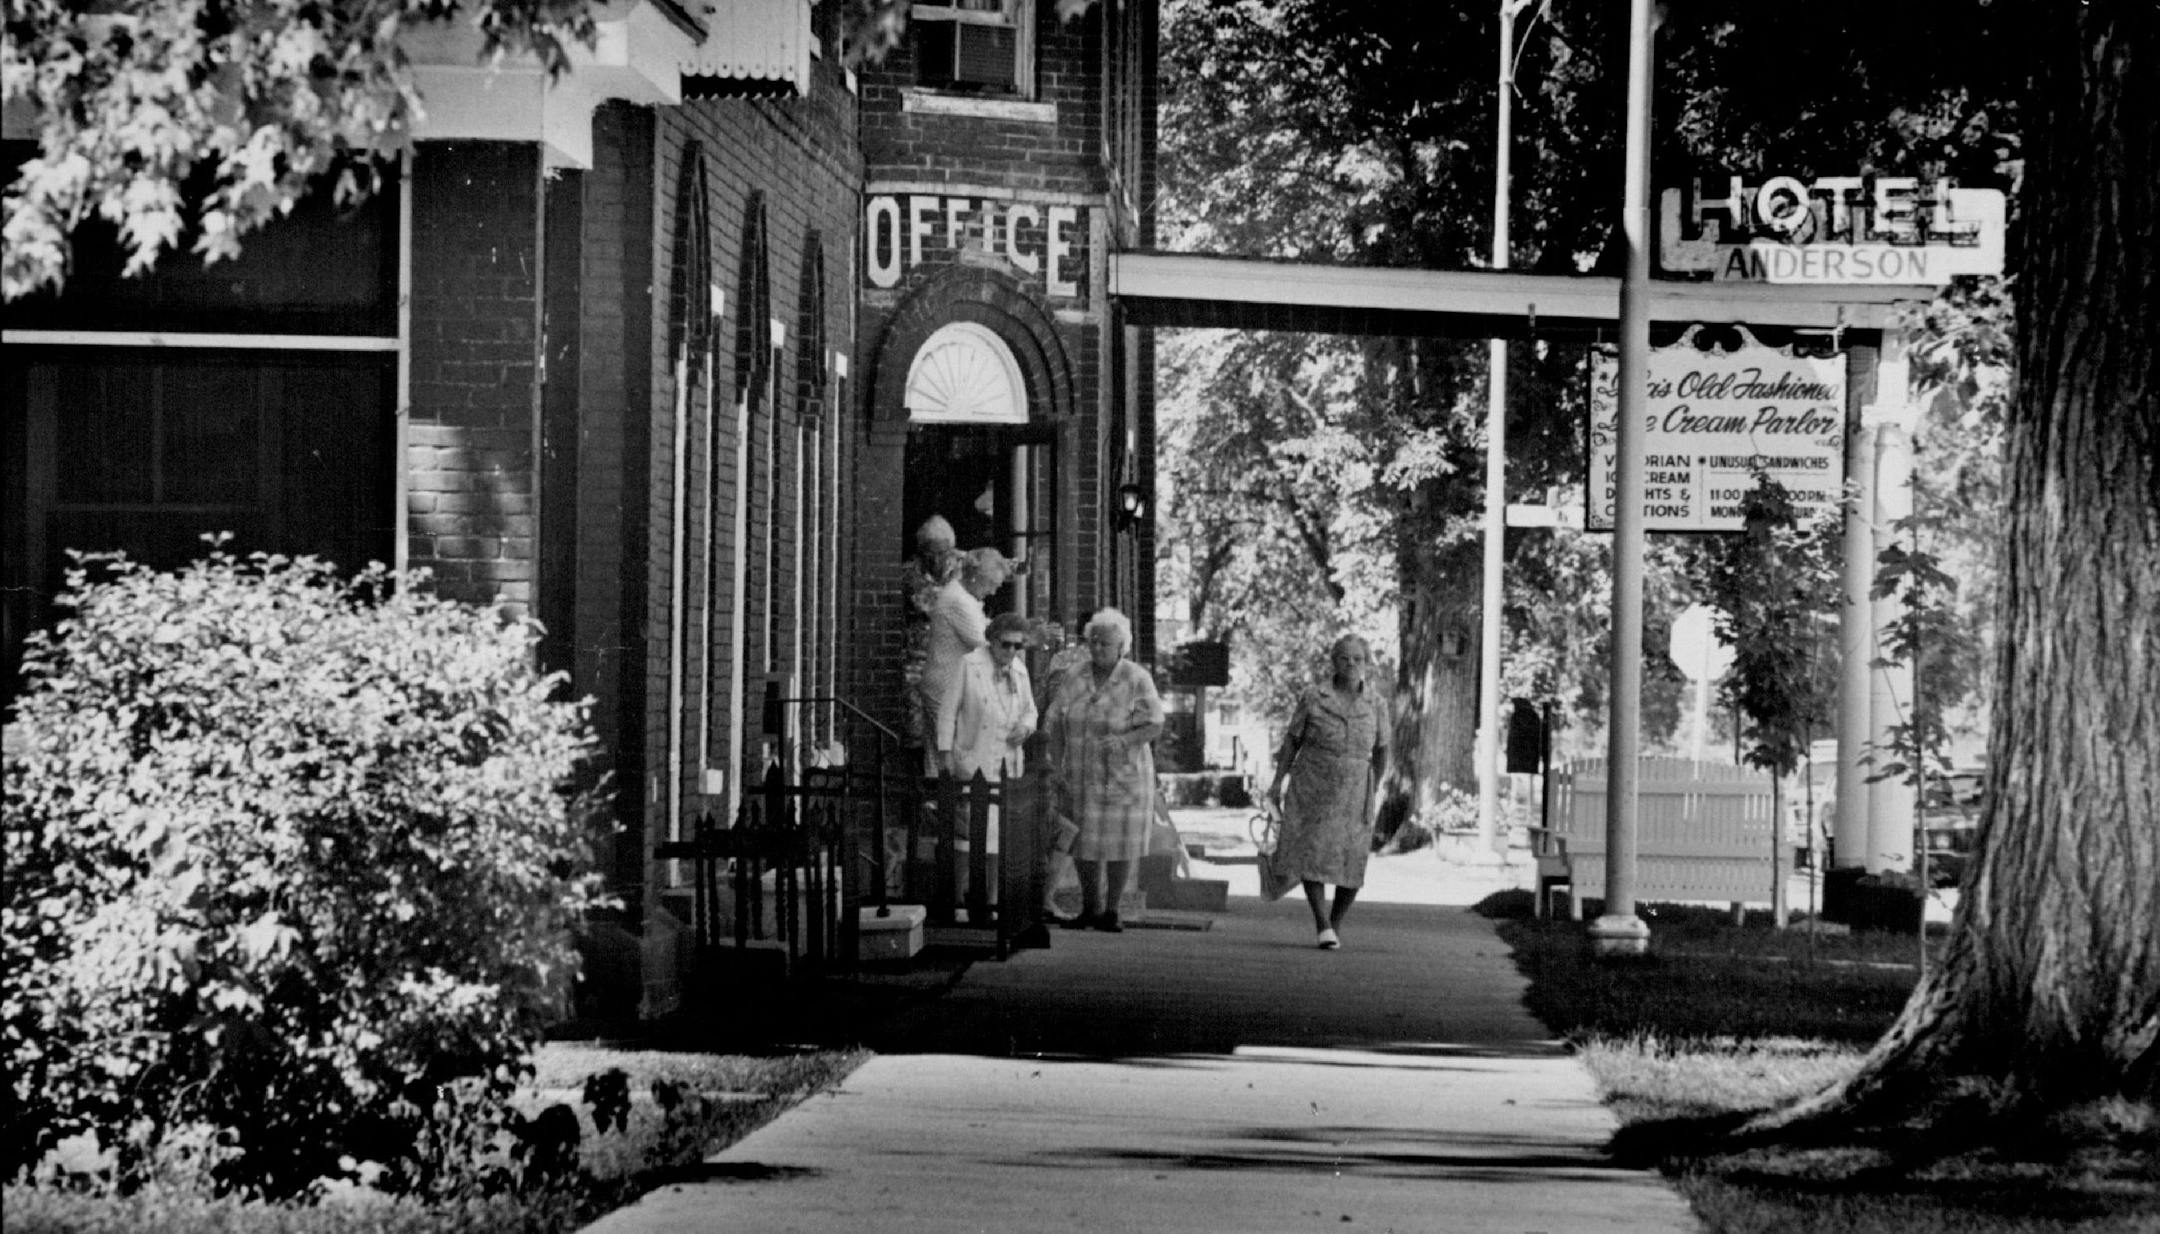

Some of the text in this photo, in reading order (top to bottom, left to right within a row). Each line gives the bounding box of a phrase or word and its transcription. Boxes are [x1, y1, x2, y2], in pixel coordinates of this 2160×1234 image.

[1693, 176, 1979, 233] HOTEL
[867, 195, 1077, 297] OFFICE
[1725, 249, 1928, 279] ANDERSON
[1677, 370, 1736, 400] Old
[1662, 404, 1748, 433] Cream
[1749, 406, 1838, 435] Parlor
[1605, 454, 1691, 468] VRIAN
[1644, 471, 1691, 485] REAM
[1606, 487, 1691, 502] DHTS &
[1605, 504, 1690, 518] CTIONS
